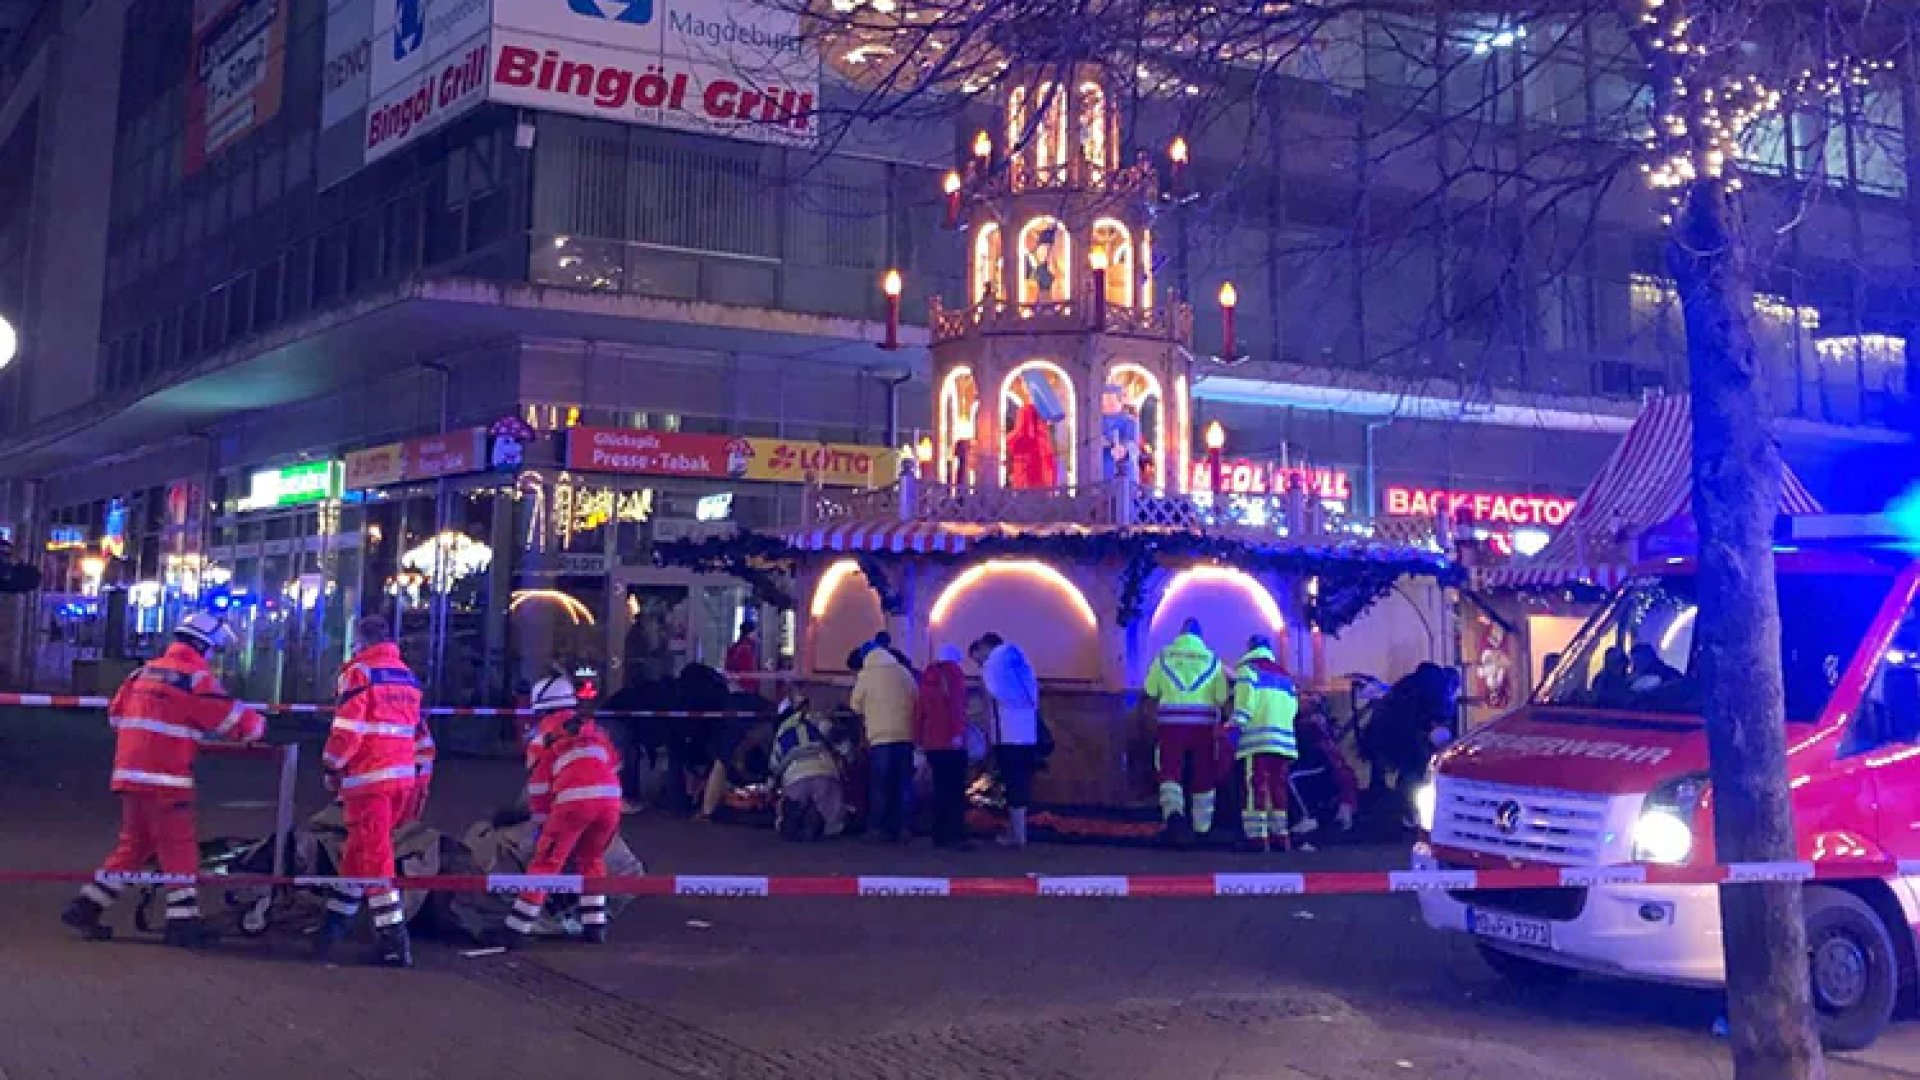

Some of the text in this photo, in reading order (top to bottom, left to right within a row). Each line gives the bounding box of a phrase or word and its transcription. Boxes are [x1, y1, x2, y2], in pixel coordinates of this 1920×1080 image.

[438, 44, 487, 107] Grill
[495, 45, 689, 108] Bingöl
[703, 79, 813, 129] Grill
[593, 449, 710, 472] Presse Tabak
[801, 450, 869, 474] LOTTO
